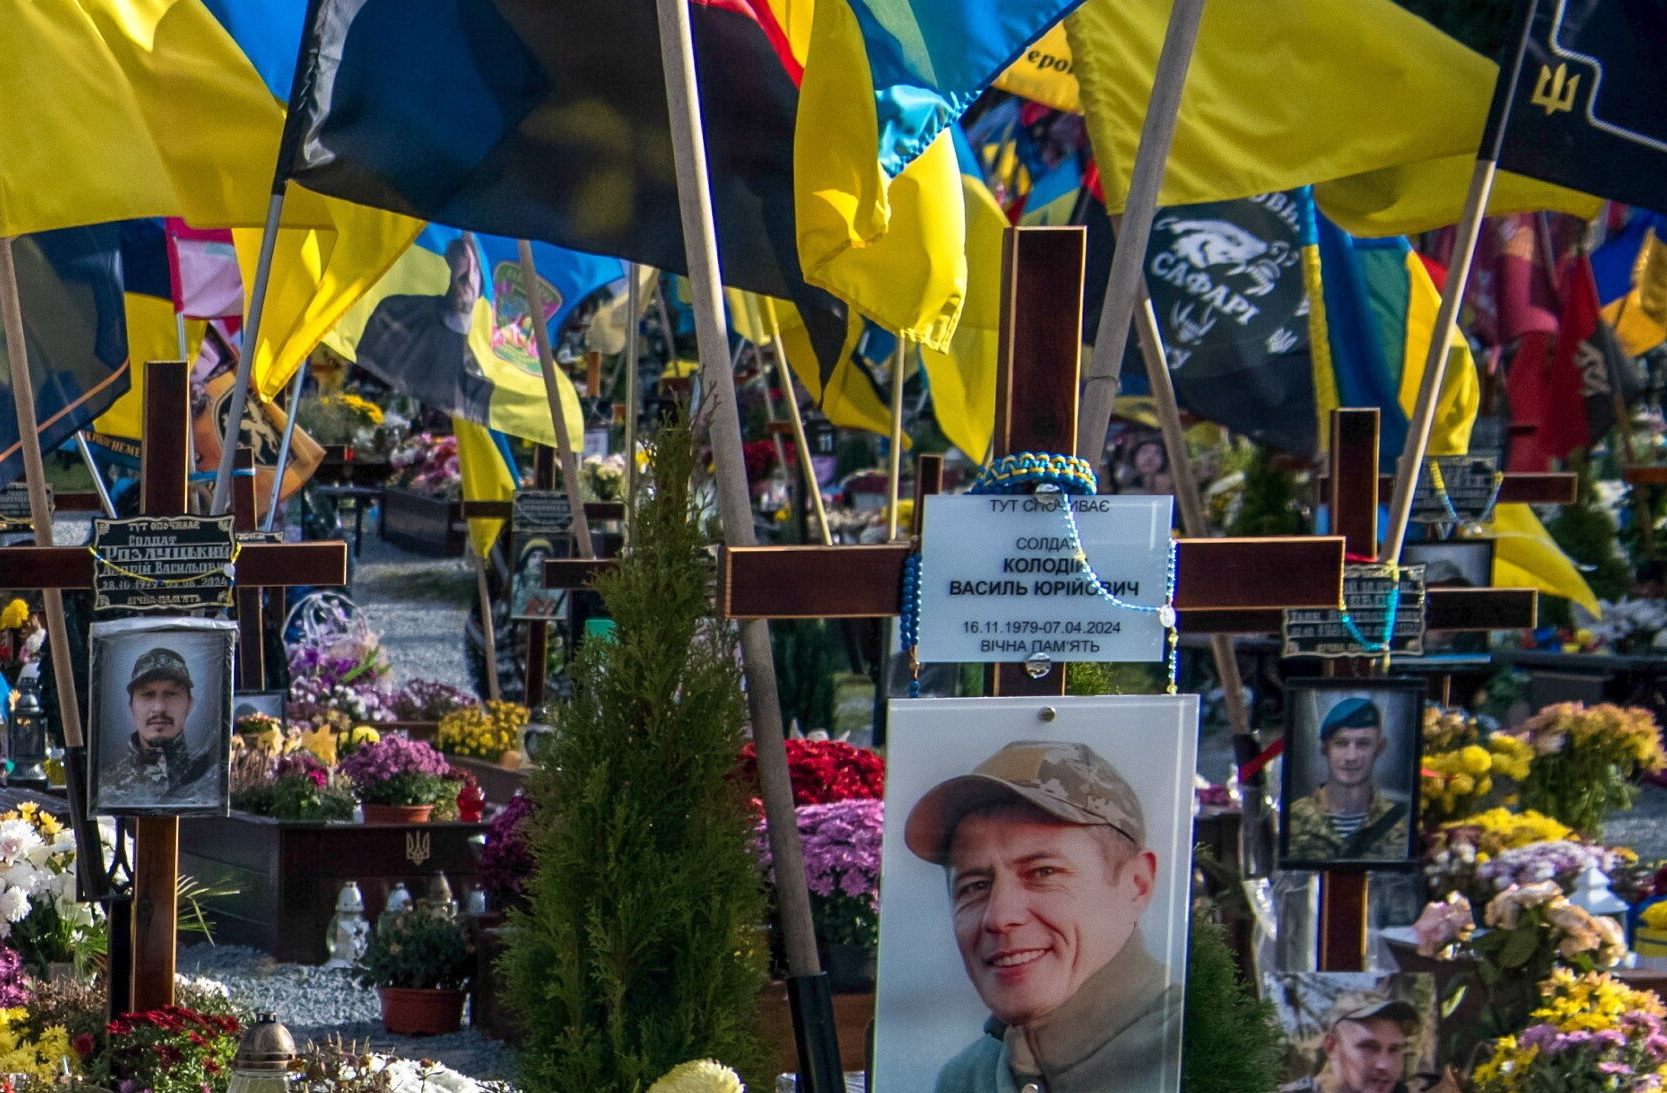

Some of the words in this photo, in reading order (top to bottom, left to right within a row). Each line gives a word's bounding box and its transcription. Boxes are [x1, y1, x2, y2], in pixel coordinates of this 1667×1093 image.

[990, 499, 1018, 512] ТУТ
[949, 580, 1028, 596] ВАСИЛЬ
[963, 621, 1122, 635] 16.11.1979-07.04.2024
[980, 639, 1028, 653] ВІЧНА
